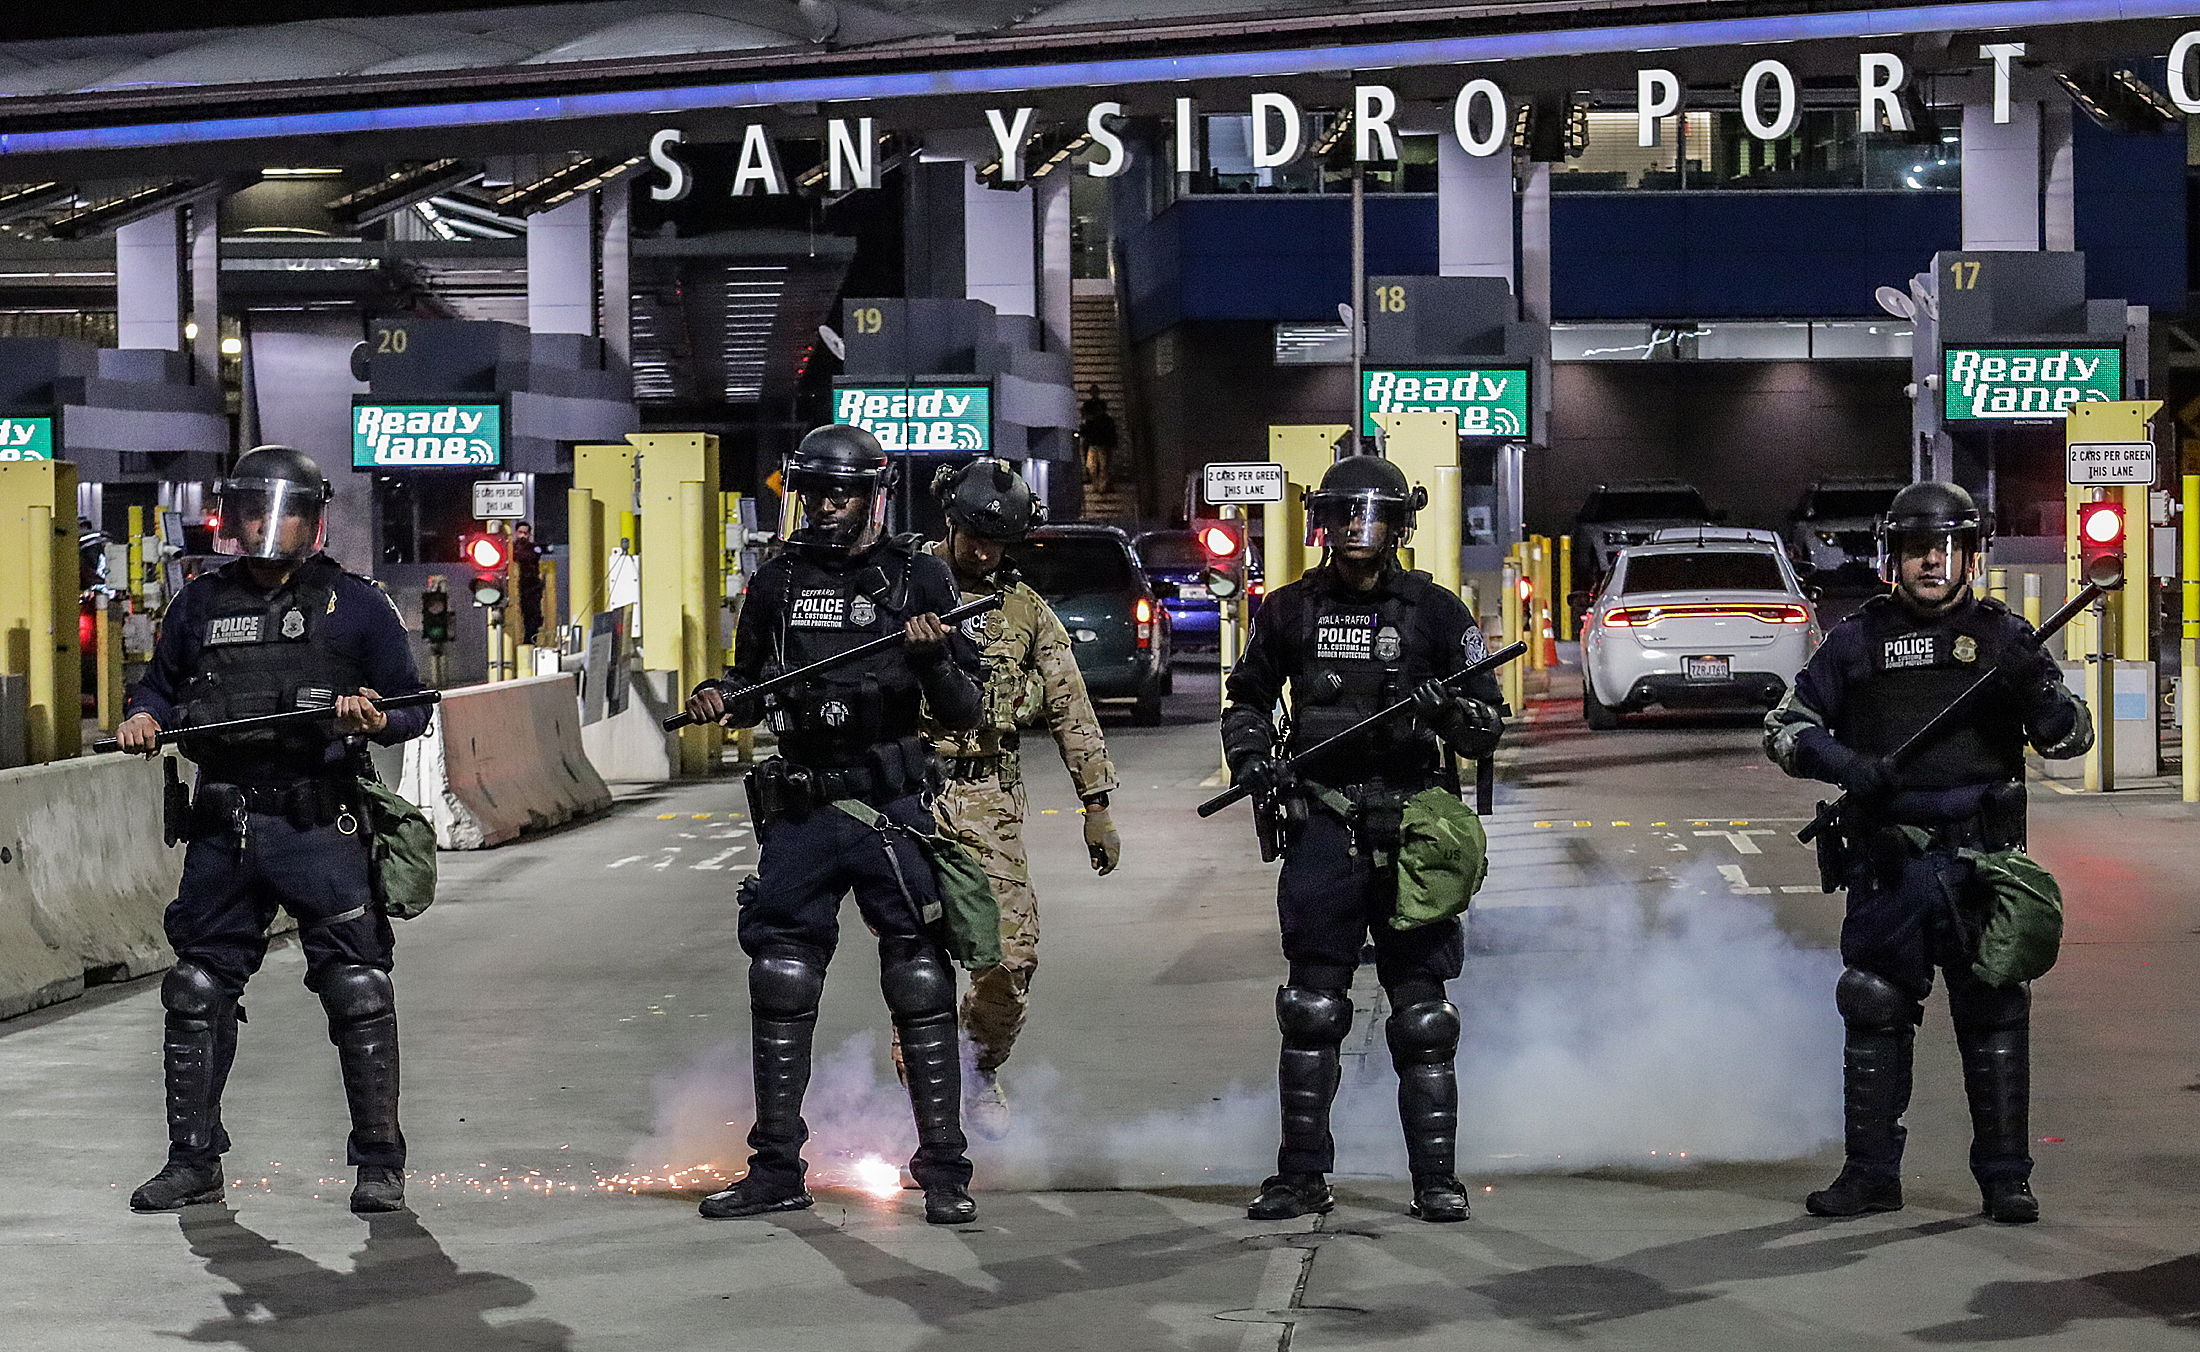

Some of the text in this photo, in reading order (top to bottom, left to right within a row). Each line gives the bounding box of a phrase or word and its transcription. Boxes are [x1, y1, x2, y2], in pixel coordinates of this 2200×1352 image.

[650, 117, 873, 200] SAN
[985, 79, 1507, 181] YSIDRO
[1638, 43, 2025, 147] PORT
[1950, 262, 1981, 289] 17
[1375, 286, 1406, 312] 18
[853, 308, 882, 333] 19
[377, 329, 407, 353] 20
[1952, 351, 2099, 396] Ready
[1368, 372, 1508, 412] Ready
[838, 389, 971, 427] Ready
[357, 406, 483, 446] Ready
[2071, 450, 2151, 461] 2 CARS PER GREEN
[1208, 471, 1280, 481] 2 CARS PER GREEN
[2088, 466, 2134, 477] THIS LANE
[1224, 485, 1265, 495] THIS LANE
[793, 598, 845, 613] POLICE
[213, 616, 259, 634] POLICE
[811, 620, 842, 628] PROTECTION
[1317, 615, 1370, 625] AYALA-RAFFO
[1318, 628, 1371, 644] POLICE
[1338, 651, 1370, 659] PROTECTION
[1884, 638, 1934, 657] POLICE
[1444, 849, 1460, 860] US
